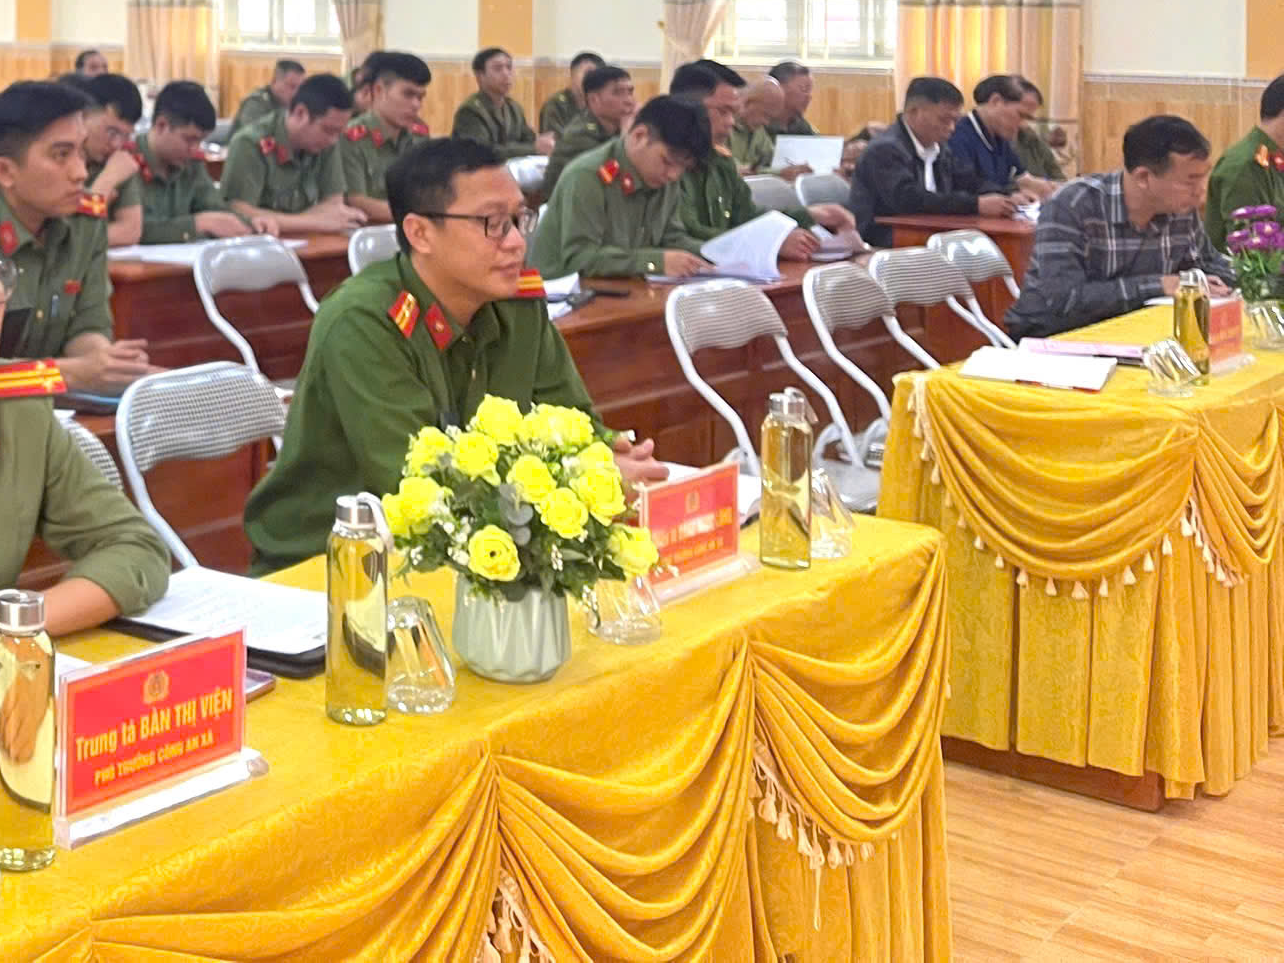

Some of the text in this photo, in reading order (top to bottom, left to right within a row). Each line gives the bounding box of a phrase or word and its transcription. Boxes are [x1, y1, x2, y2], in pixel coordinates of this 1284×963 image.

[76, 729, 118, 761] Trung
[140, 707, 171, 738] BÀN
[175, 699, 197, 726] THỊ
